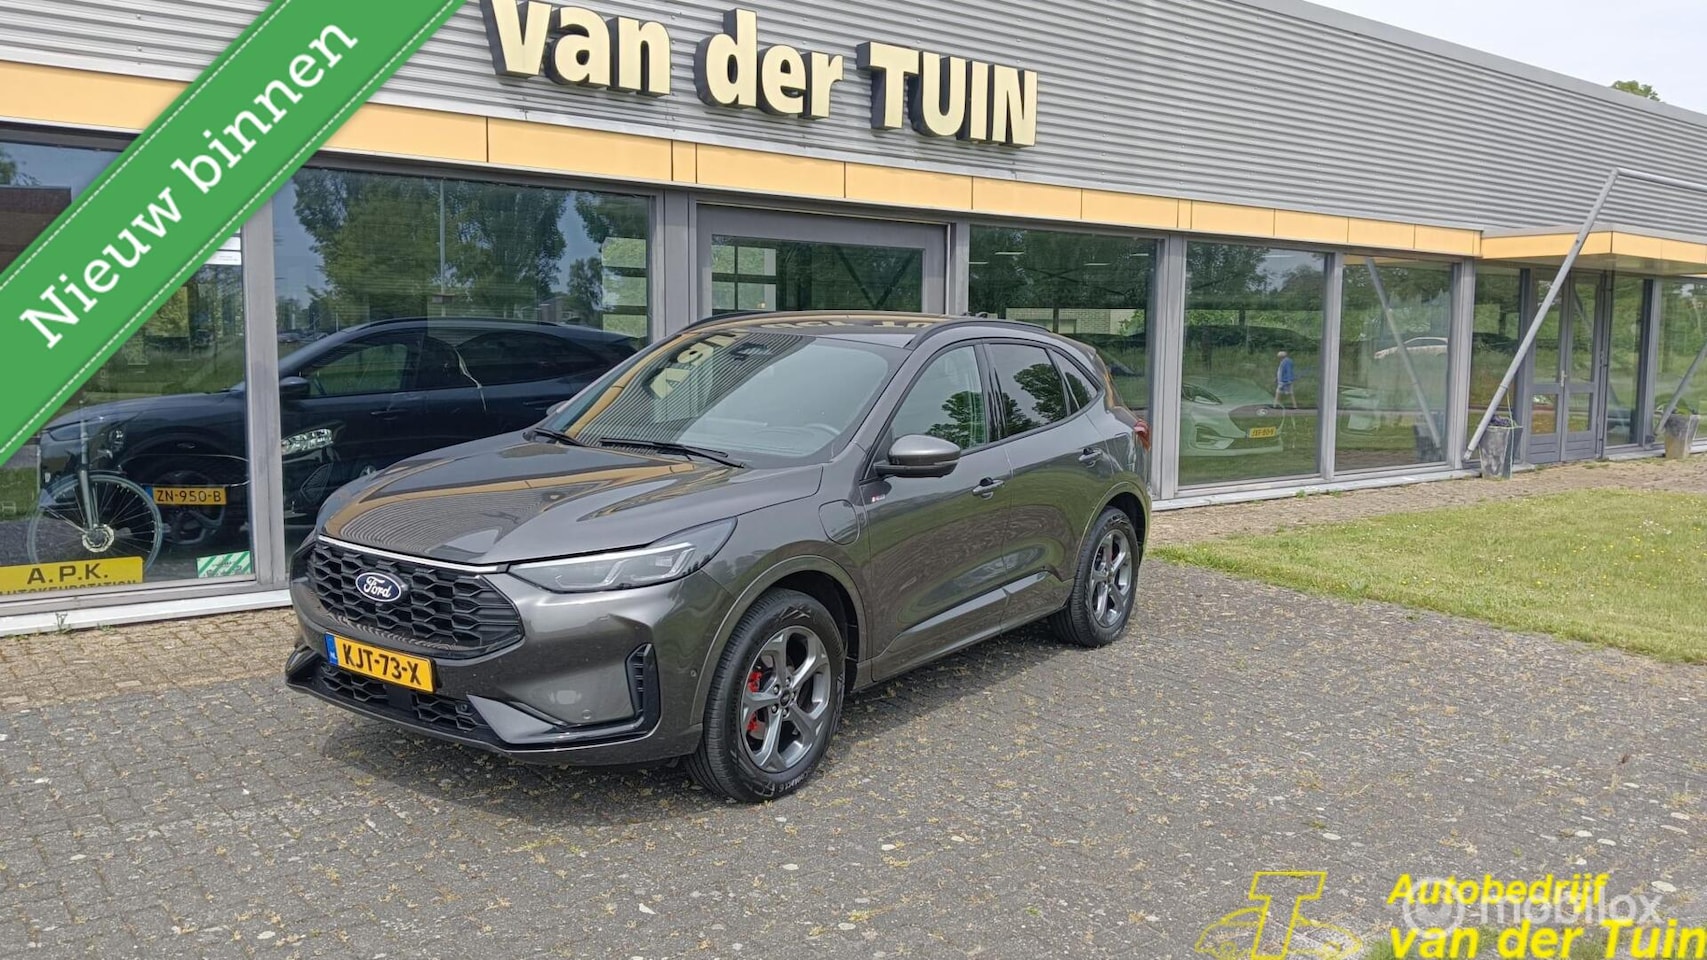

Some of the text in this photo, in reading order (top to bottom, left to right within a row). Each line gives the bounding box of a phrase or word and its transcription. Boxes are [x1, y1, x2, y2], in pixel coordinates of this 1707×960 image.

[488, 0, 1039, 148] van der TUIN
[156, 489, 222, 503] ZN-950-B
[27, 563, 109, 585] A.P.K.
[363, 576, 392, 598] Ford
[342, 643, 422, 685] KJT-73-X
